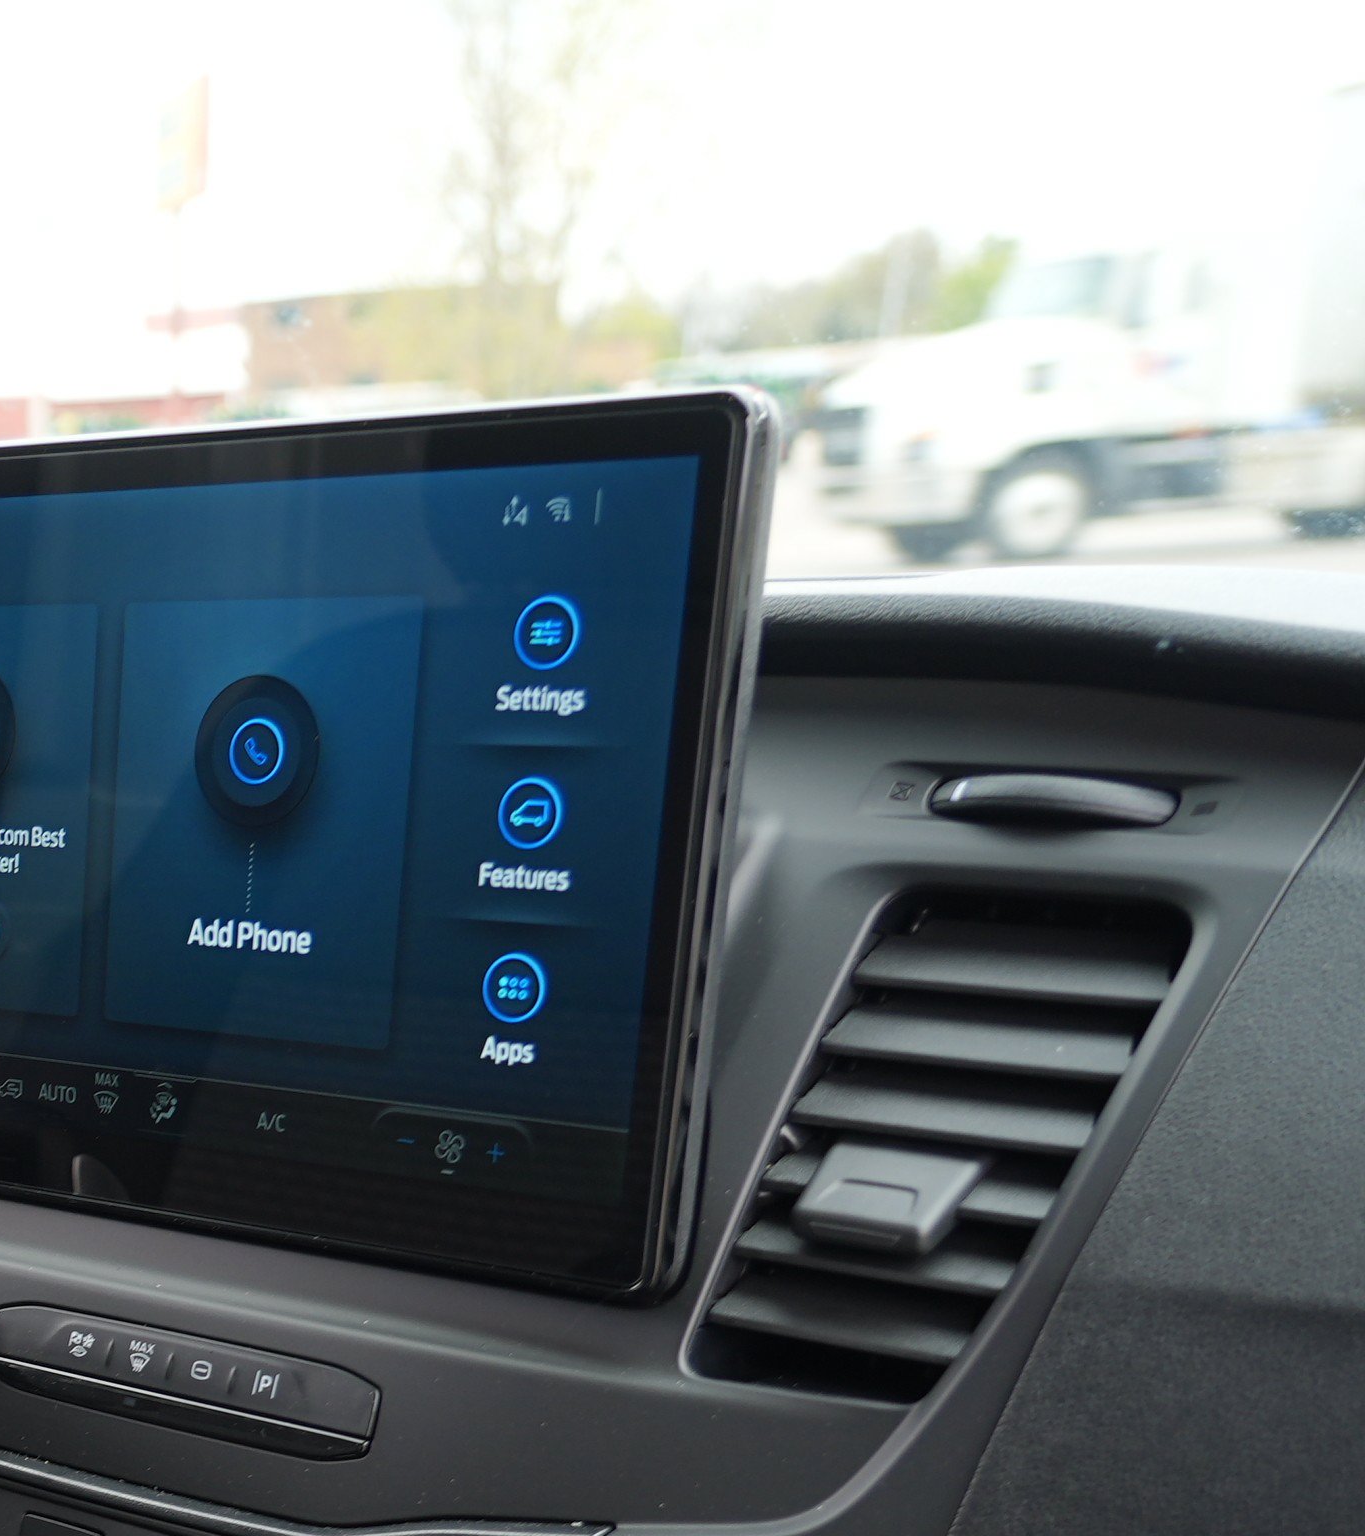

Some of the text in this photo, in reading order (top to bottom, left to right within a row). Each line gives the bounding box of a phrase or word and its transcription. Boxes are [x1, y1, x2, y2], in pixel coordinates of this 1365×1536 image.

[494, 683, 586, 717] Settings
[30, 825, 67, 849] Best
[477, 861, 571, 892] Features
[186, 917, 312, 955] Add Phone
[479, 1034, 536, 1067] Apps
[94, 1071, 119, 1088] MAX
[37, 1082, 78, 1104] AUTO
[254, 1111, 287, 1133] A/C
[128, 1339, 157, 1356] MAX
